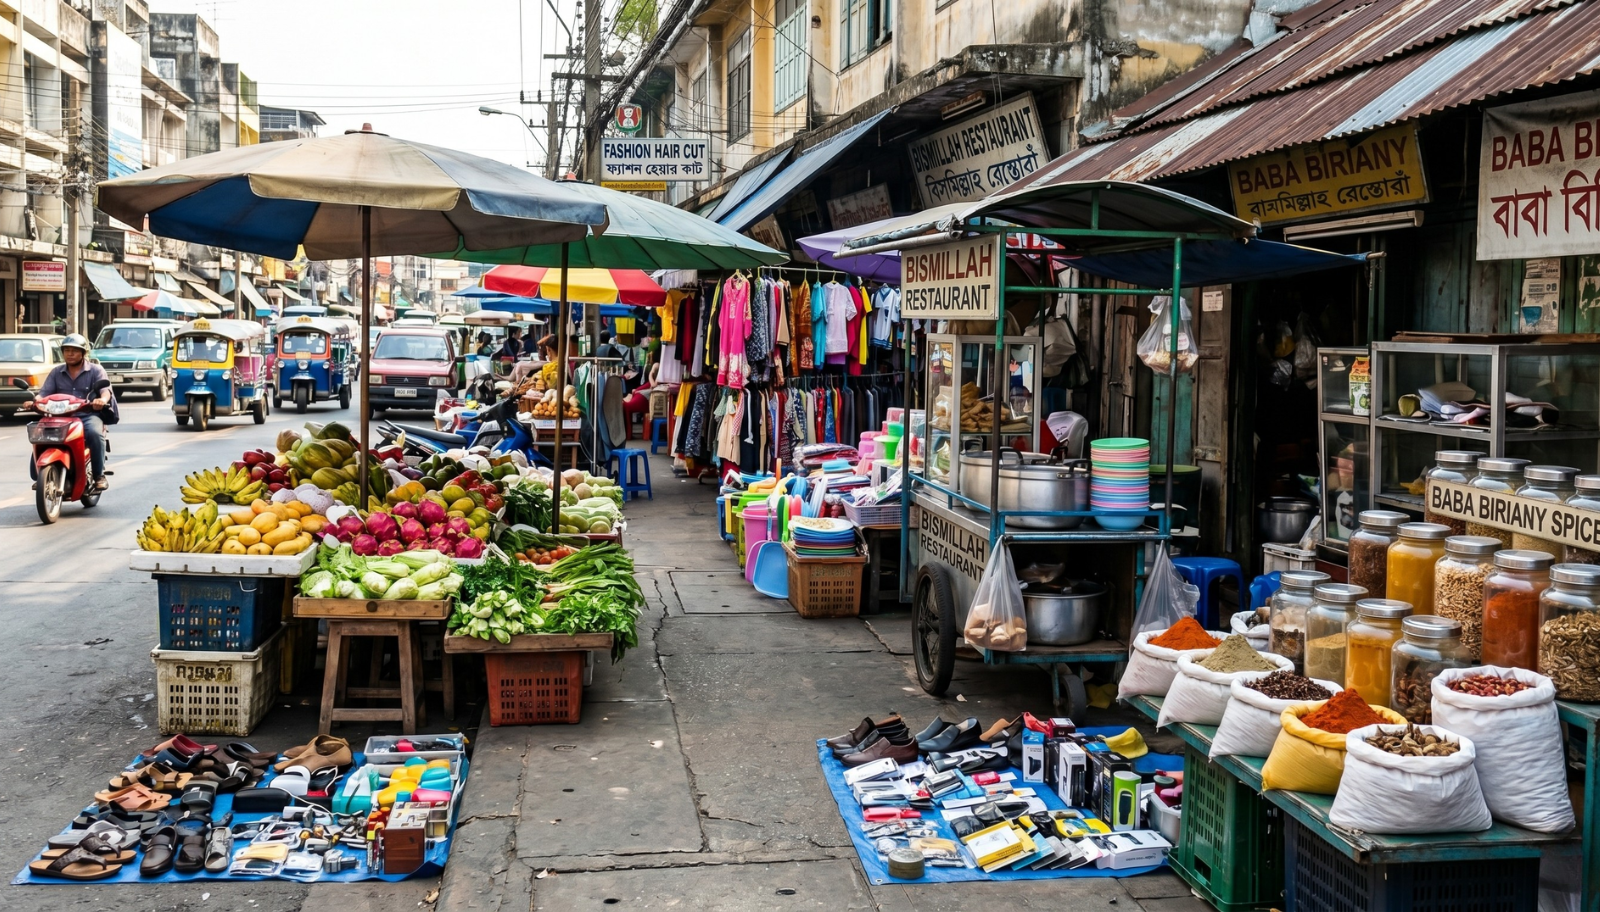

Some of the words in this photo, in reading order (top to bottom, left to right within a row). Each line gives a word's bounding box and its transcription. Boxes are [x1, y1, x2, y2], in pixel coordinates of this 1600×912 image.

[604, 143, 651, 159] FASHION
[654, 143, 681, 159] HAIR
[683, 143, 706, 159] CUT
[911, 132, 964, 173] BISMILLAH
[961, 106, 1035, 159] RESTAURANT
[1491, 125, 1566, 173] BABA
[605, 163, 643, 176] ফ্যাশন
[645, 163, 678, 177] হেয়ার
[681, 161, 703, 175] কাট
[1236, 159, 1302, 195] BABA
[1305, 134, 1409, 183] BIRIANY
[1490, 184, 1553, 239] বাবা
[906, 243, 993, 284] BISMILLAH
[905, 283, 991, 311] RESTAURANT
[1432, 485, 1475, 517] BABA
[1478, 494, 1548, 532] BIRIANY
[921, 510, 984, 563] BISMILLAH
[921, 533, 984, 582] RESTAURANT
